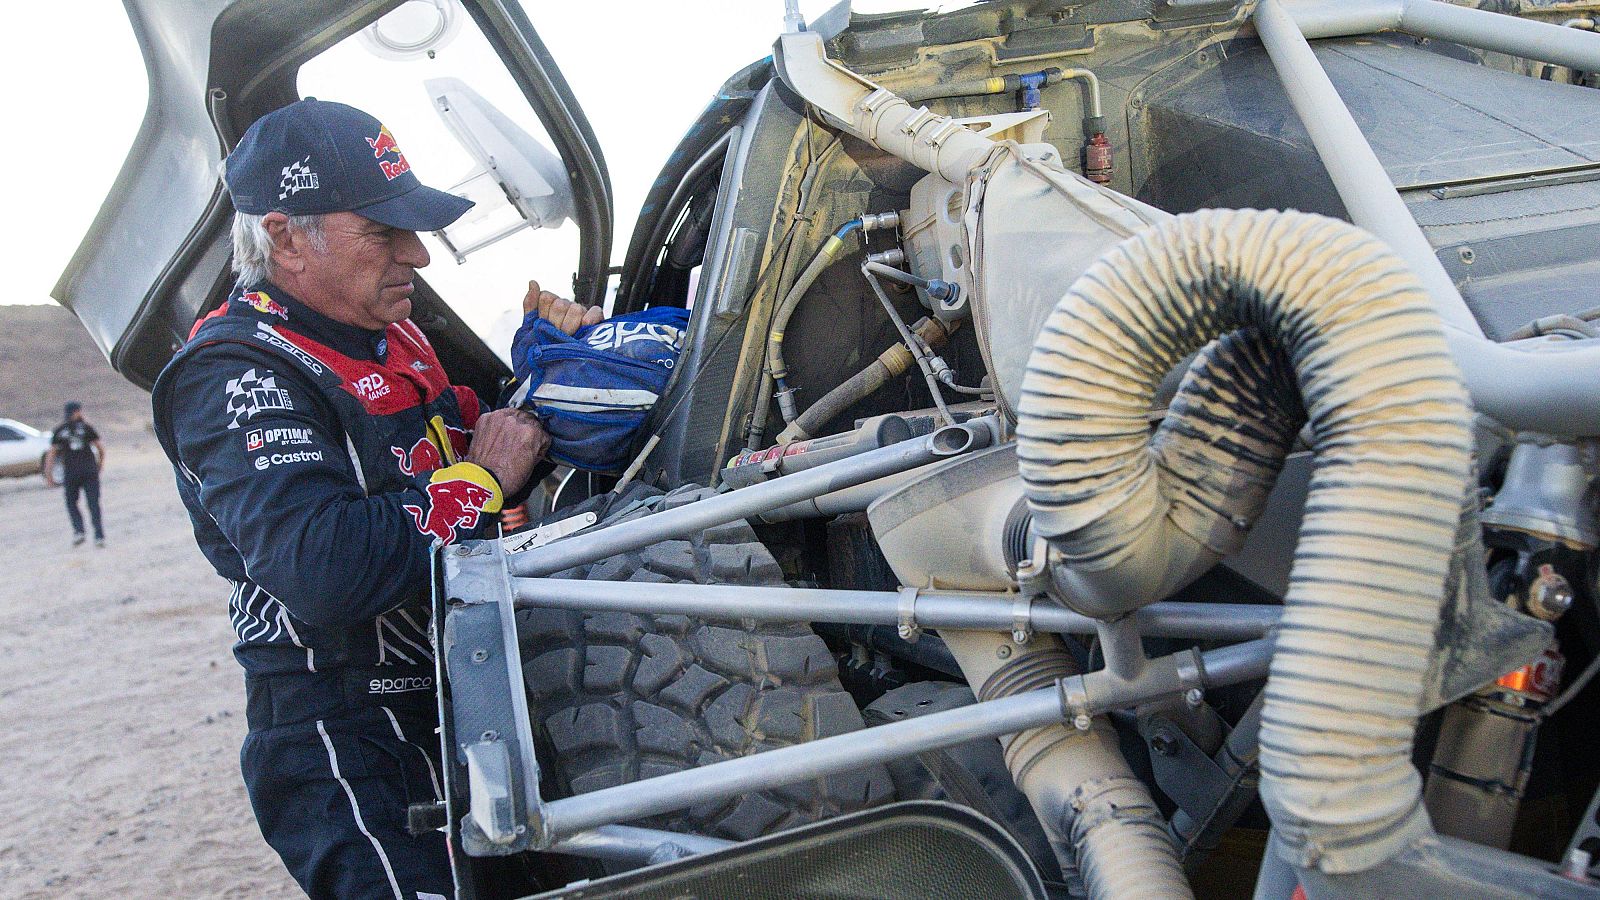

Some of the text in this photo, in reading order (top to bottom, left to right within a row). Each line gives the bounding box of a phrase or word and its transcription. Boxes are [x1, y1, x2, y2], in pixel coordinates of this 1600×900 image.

[379, 153, 410, 181] Red
[253, 331, 323, 376] sparco
[352, 373, 384, 397] RD
[270, 450, 323, 465] Castrol
[369, 676, 432, 694] sparco
